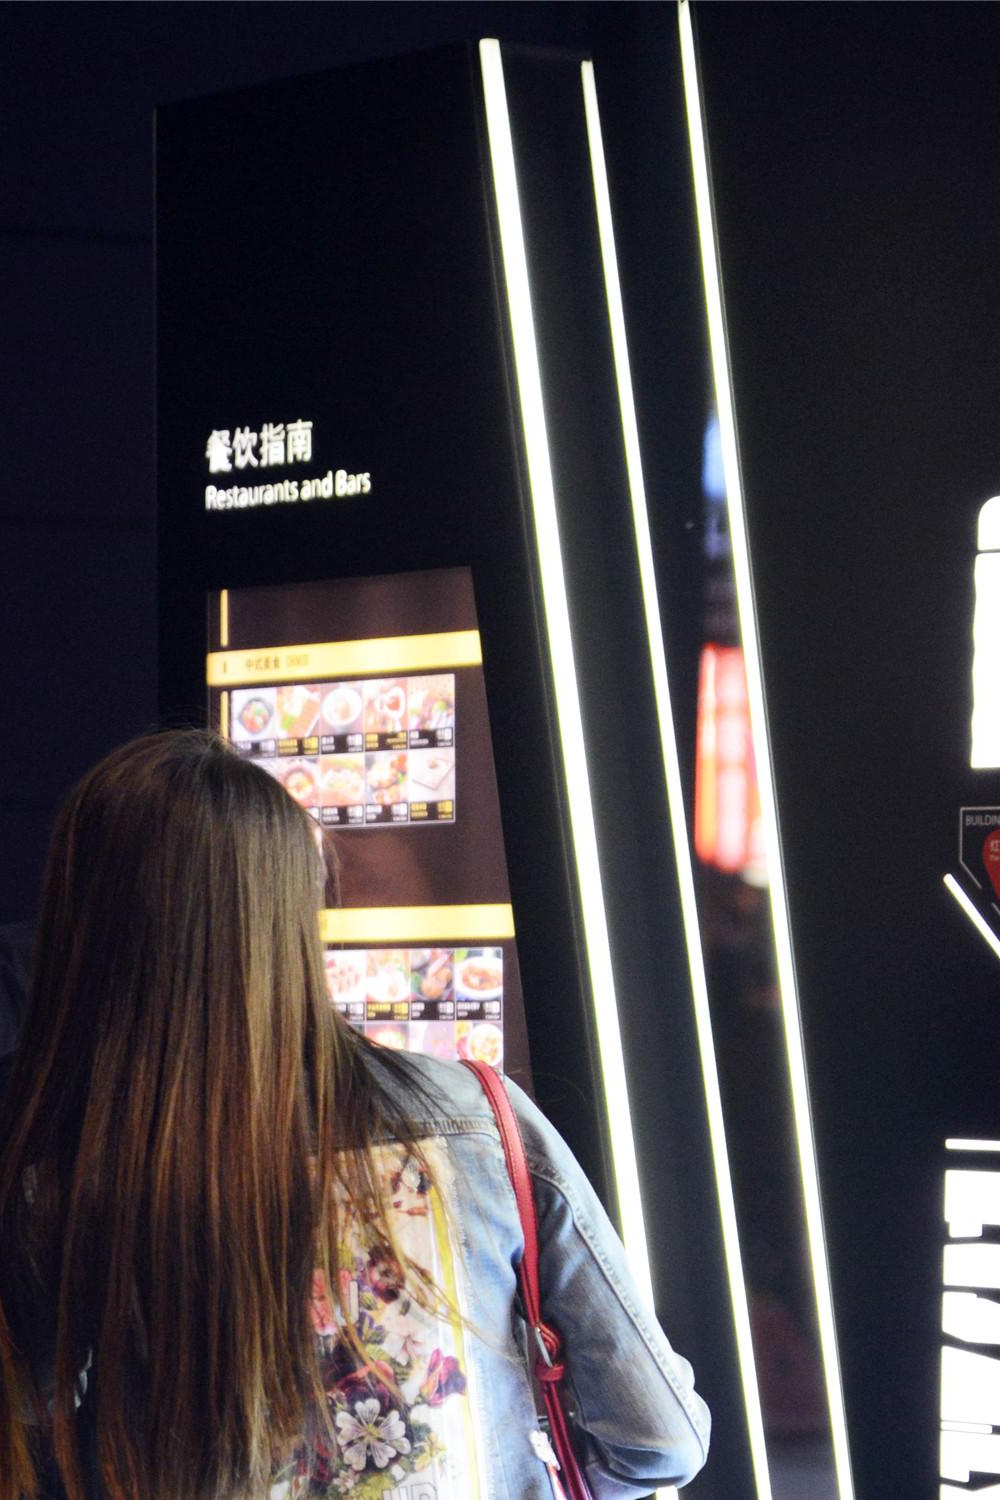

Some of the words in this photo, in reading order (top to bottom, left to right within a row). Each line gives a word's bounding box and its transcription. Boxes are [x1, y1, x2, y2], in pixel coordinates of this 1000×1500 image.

[205, 419, 313, 473] 餐饮指南
[205, 480, 299, 511] Restaurants
[300, 470, 333, 501] and
[335, 469, 371, 497] Bars
